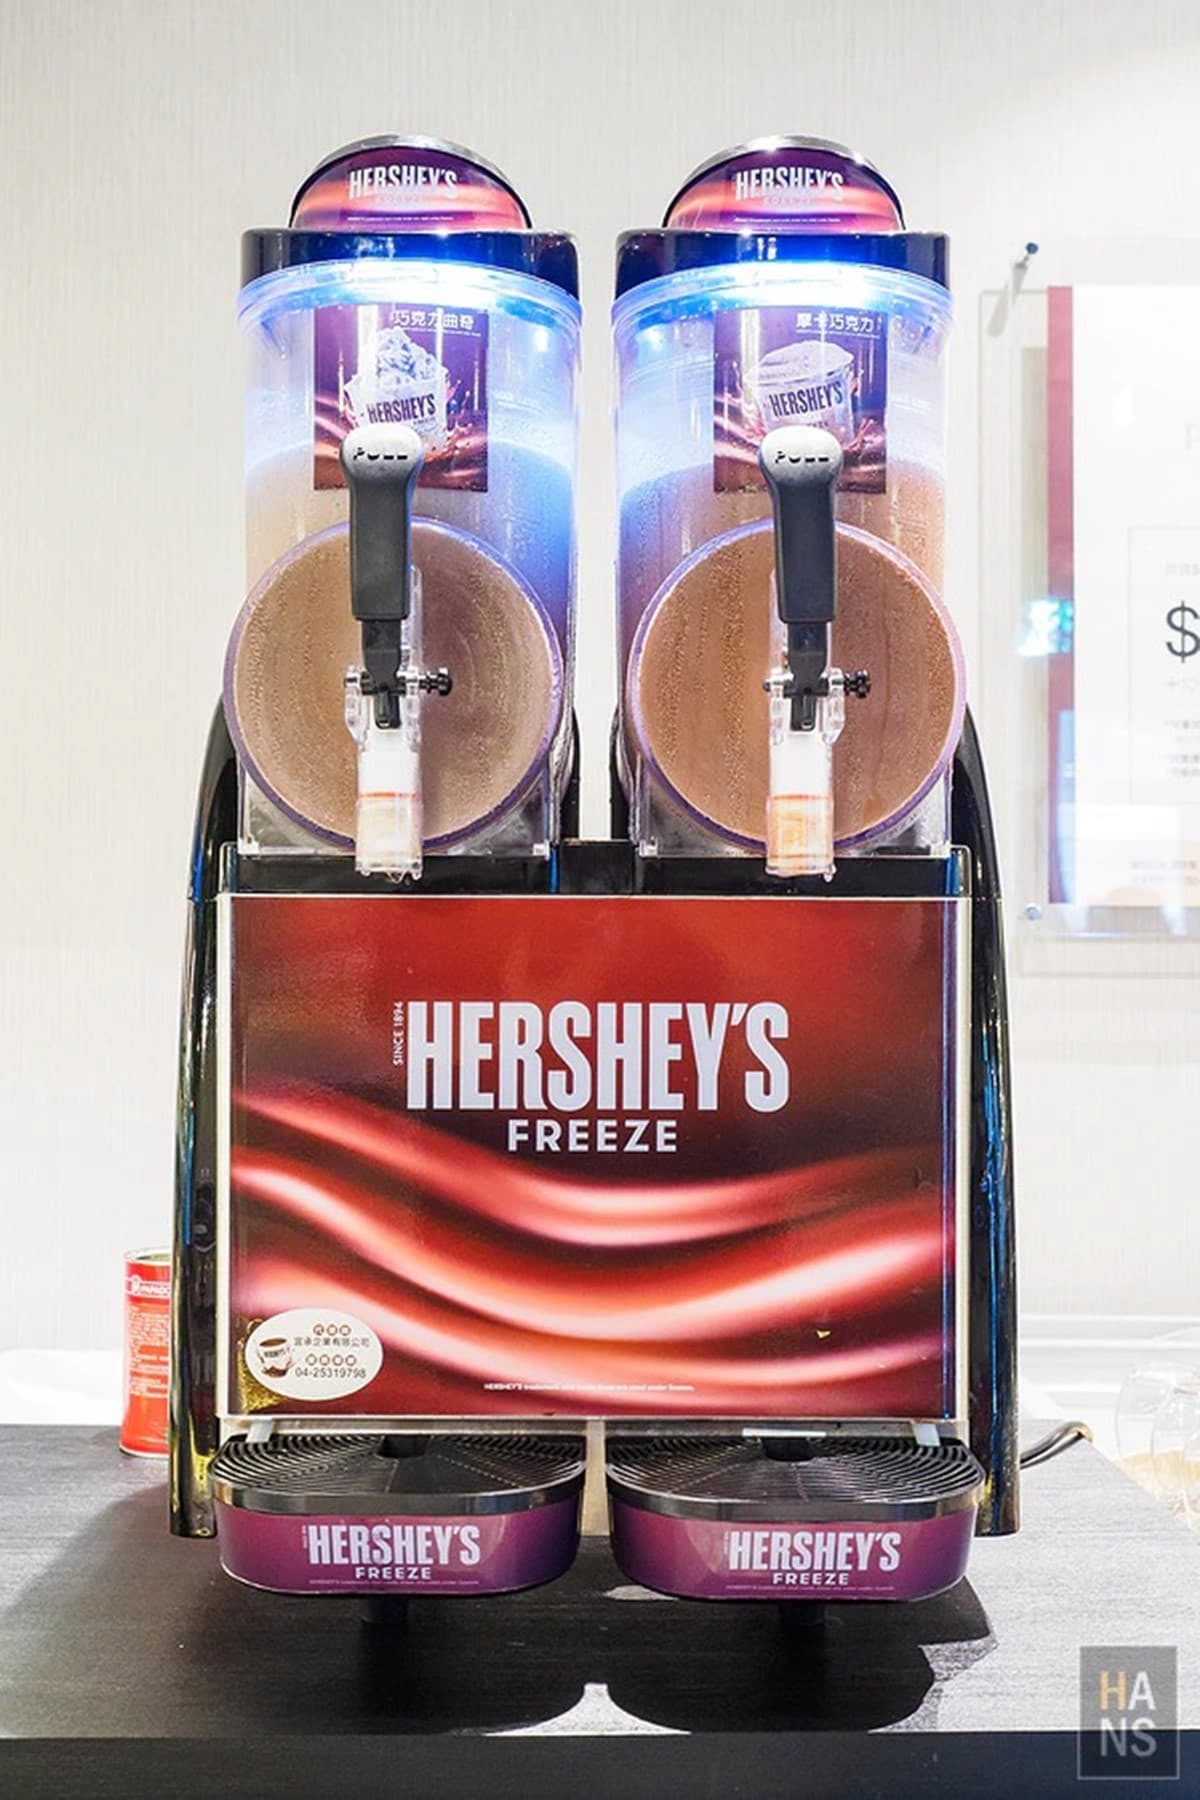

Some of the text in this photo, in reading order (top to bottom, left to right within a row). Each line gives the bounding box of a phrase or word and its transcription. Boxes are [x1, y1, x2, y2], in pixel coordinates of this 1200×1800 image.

[349, 165, 458, 200] HERSHEY'S
[735, 165, 844, 201] HERSHEY'S
[393, 1031, 404, 1066] SINCE
[407, 1001, 790, 1113] HERSHEY'S
[507, 1119, 678, 1152] FREEZE
[308, 1525, 480, 1566] HERSHEY'S
[729, 1531, 901, 1571] HERSHEY'S
[355, 1567, 432, 1580] FREEZE
[772, 1572, 849, 1585] FREEZE
